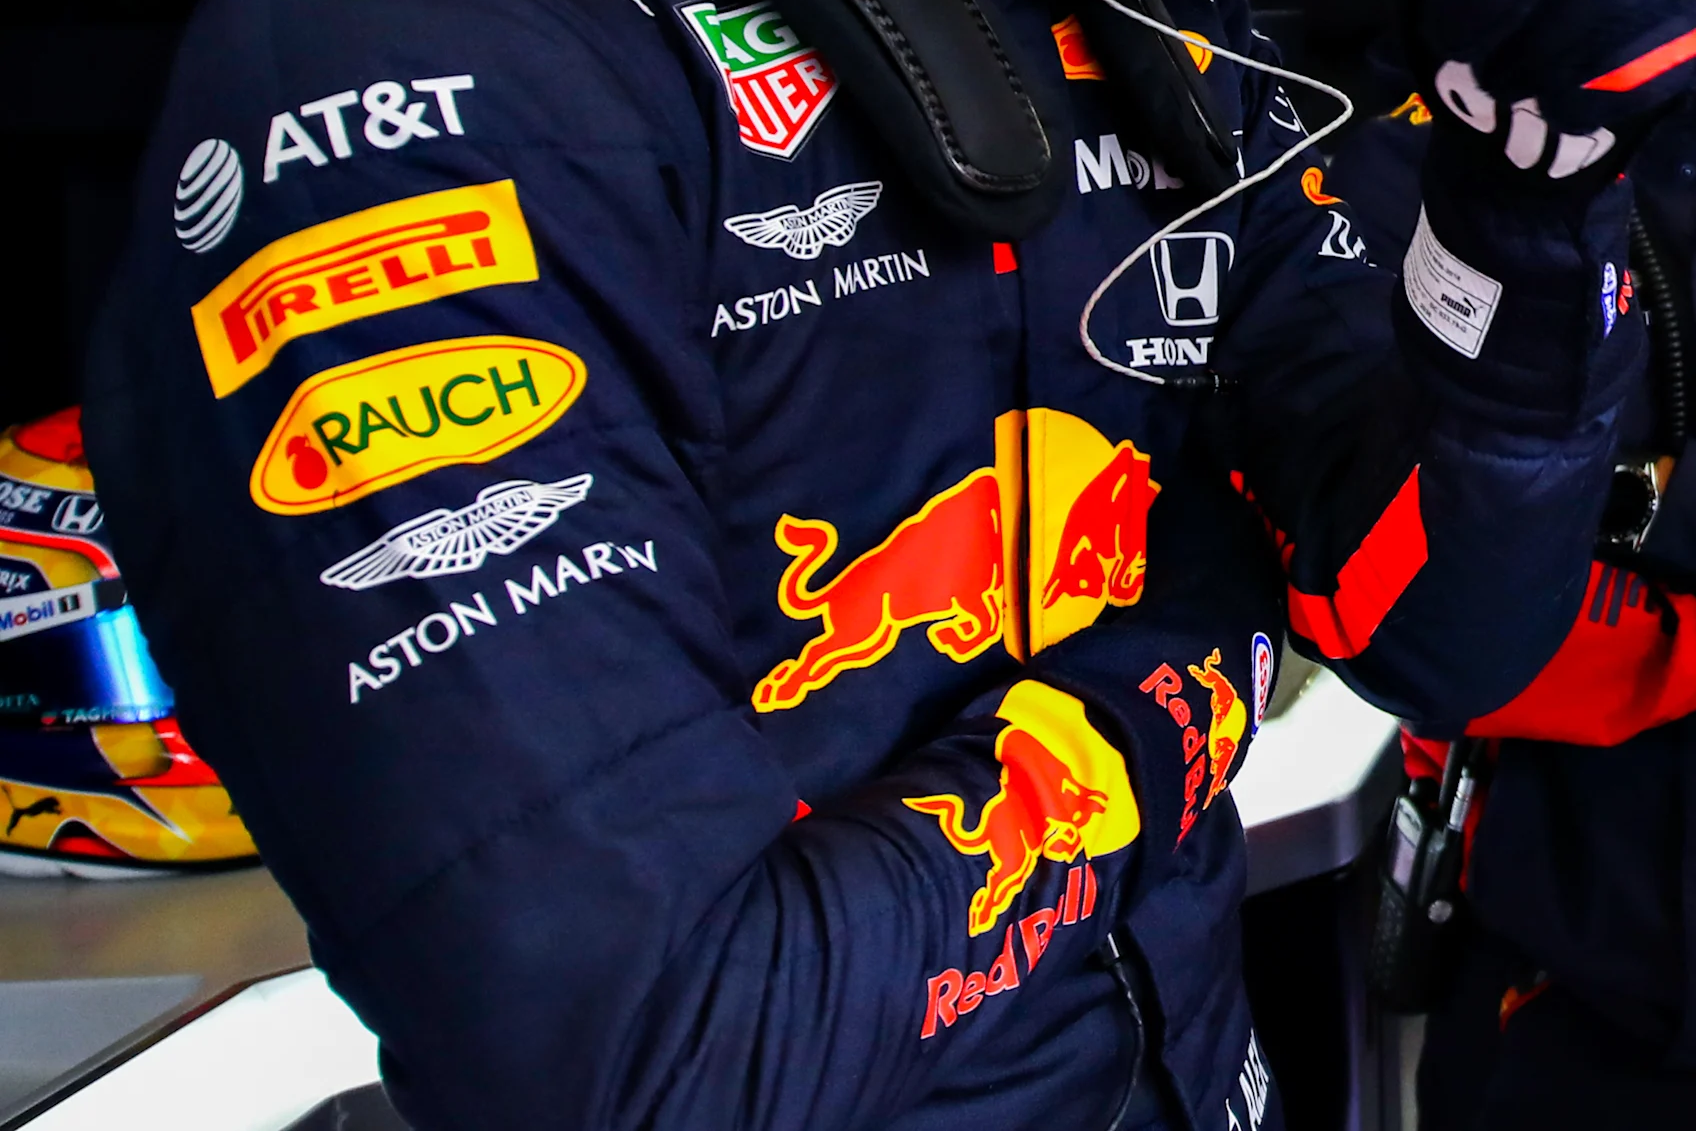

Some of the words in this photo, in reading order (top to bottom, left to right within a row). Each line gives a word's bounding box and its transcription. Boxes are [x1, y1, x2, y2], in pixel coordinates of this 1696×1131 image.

[262, 74, 474, 183] AT&T
[219, 210, 498, 365] PIRELLI
[711, 278, 822, 338] ASTON
[833, 249, 931, 299] MARTIN
[1441, 292, 1472, 319] PUMA
[1125, 335, 1215, 368] HON
[312, 358, 542, 467] RAUCH
[408, 514, 466, 550] ASTON
[467, 490, 534, 525] MARTIN
[348, 592, 498, 704] ASTON
[1138, 661, 1207, 765] Red
[920, 923, 1020, 1040] Red
